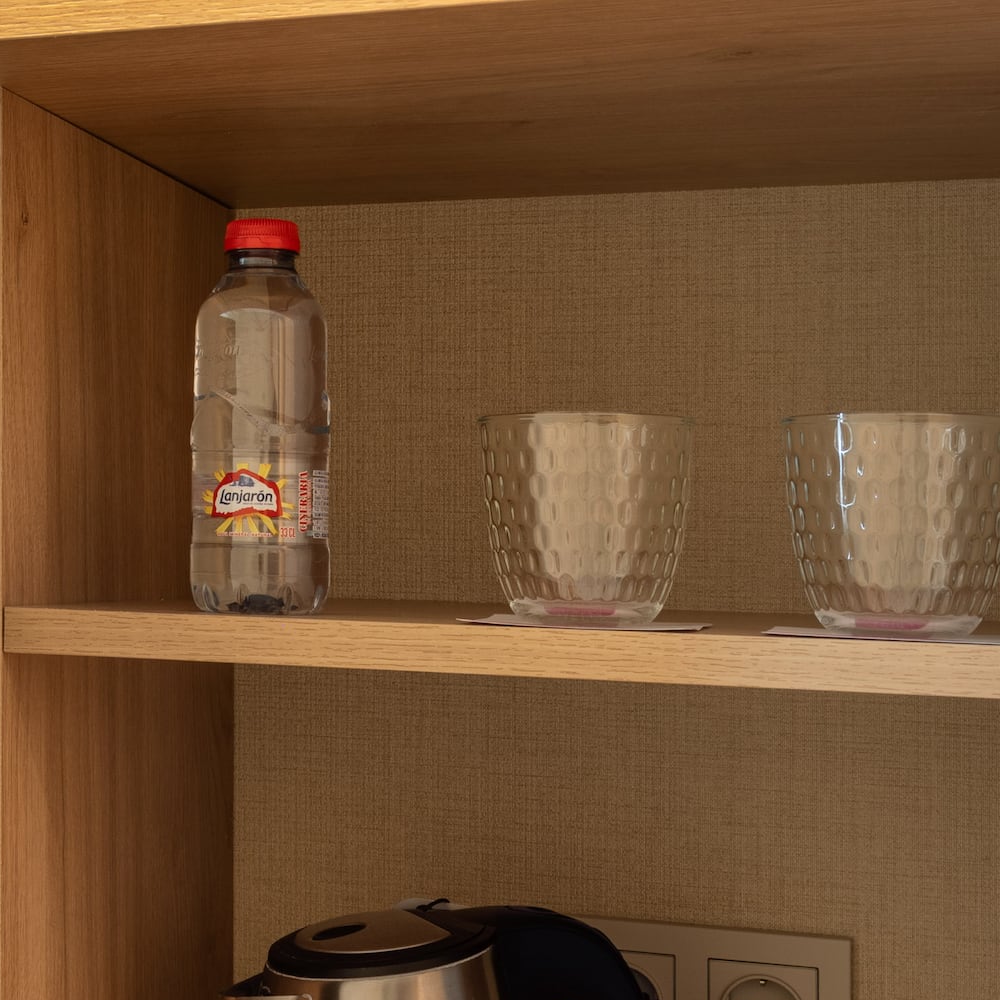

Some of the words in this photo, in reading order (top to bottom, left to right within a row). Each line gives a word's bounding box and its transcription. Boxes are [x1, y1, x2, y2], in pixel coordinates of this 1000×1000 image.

[219, 488, 273, 505] Lanjarón
[281, 527, 288, 538] 33
[289, 527, 296, 538] CL
